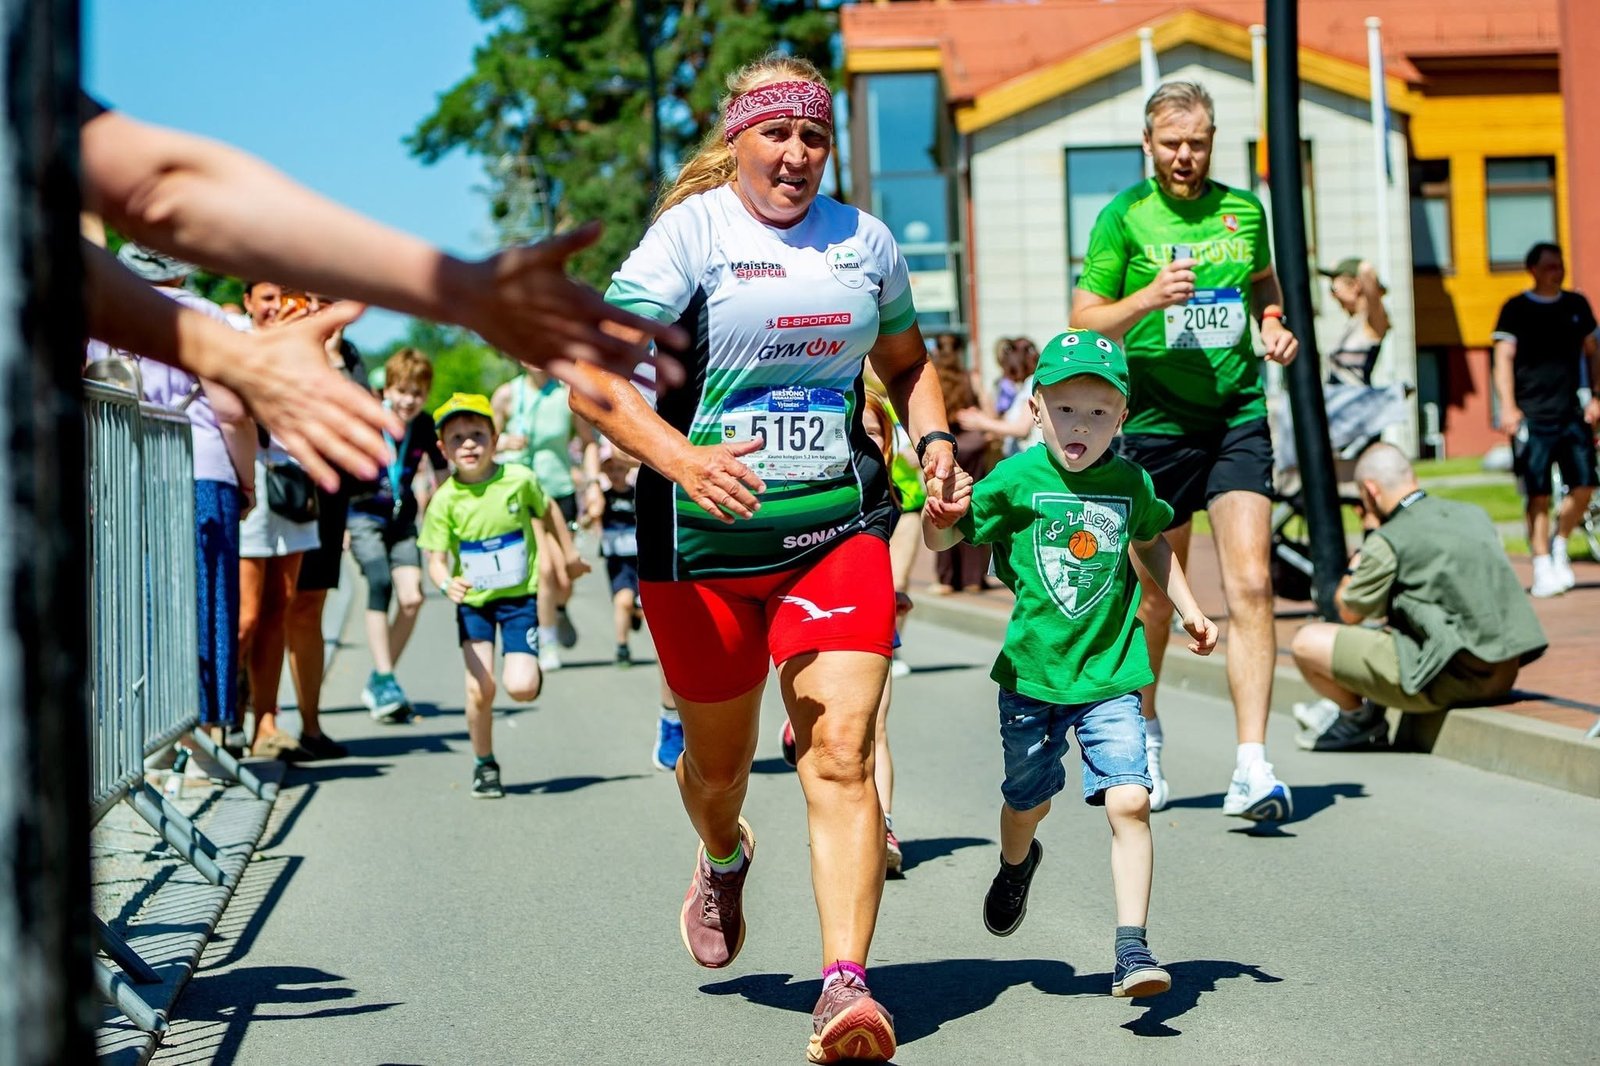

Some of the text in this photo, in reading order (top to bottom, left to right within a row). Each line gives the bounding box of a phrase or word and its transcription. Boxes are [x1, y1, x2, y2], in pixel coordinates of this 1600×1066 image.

[731, 260, 782, 270] Maistas
[736, 268, 786, 280] Sportui
[780, 314, 850, 327] S-SPORTAS
[1183, 306, 1230, 331] 2042
[758, 337, 846, 361] GYMON
[751, 415, 825, 452] 5152
[1044, 519, 1065, 542] BC
[494, 553, 500, 571] 1
